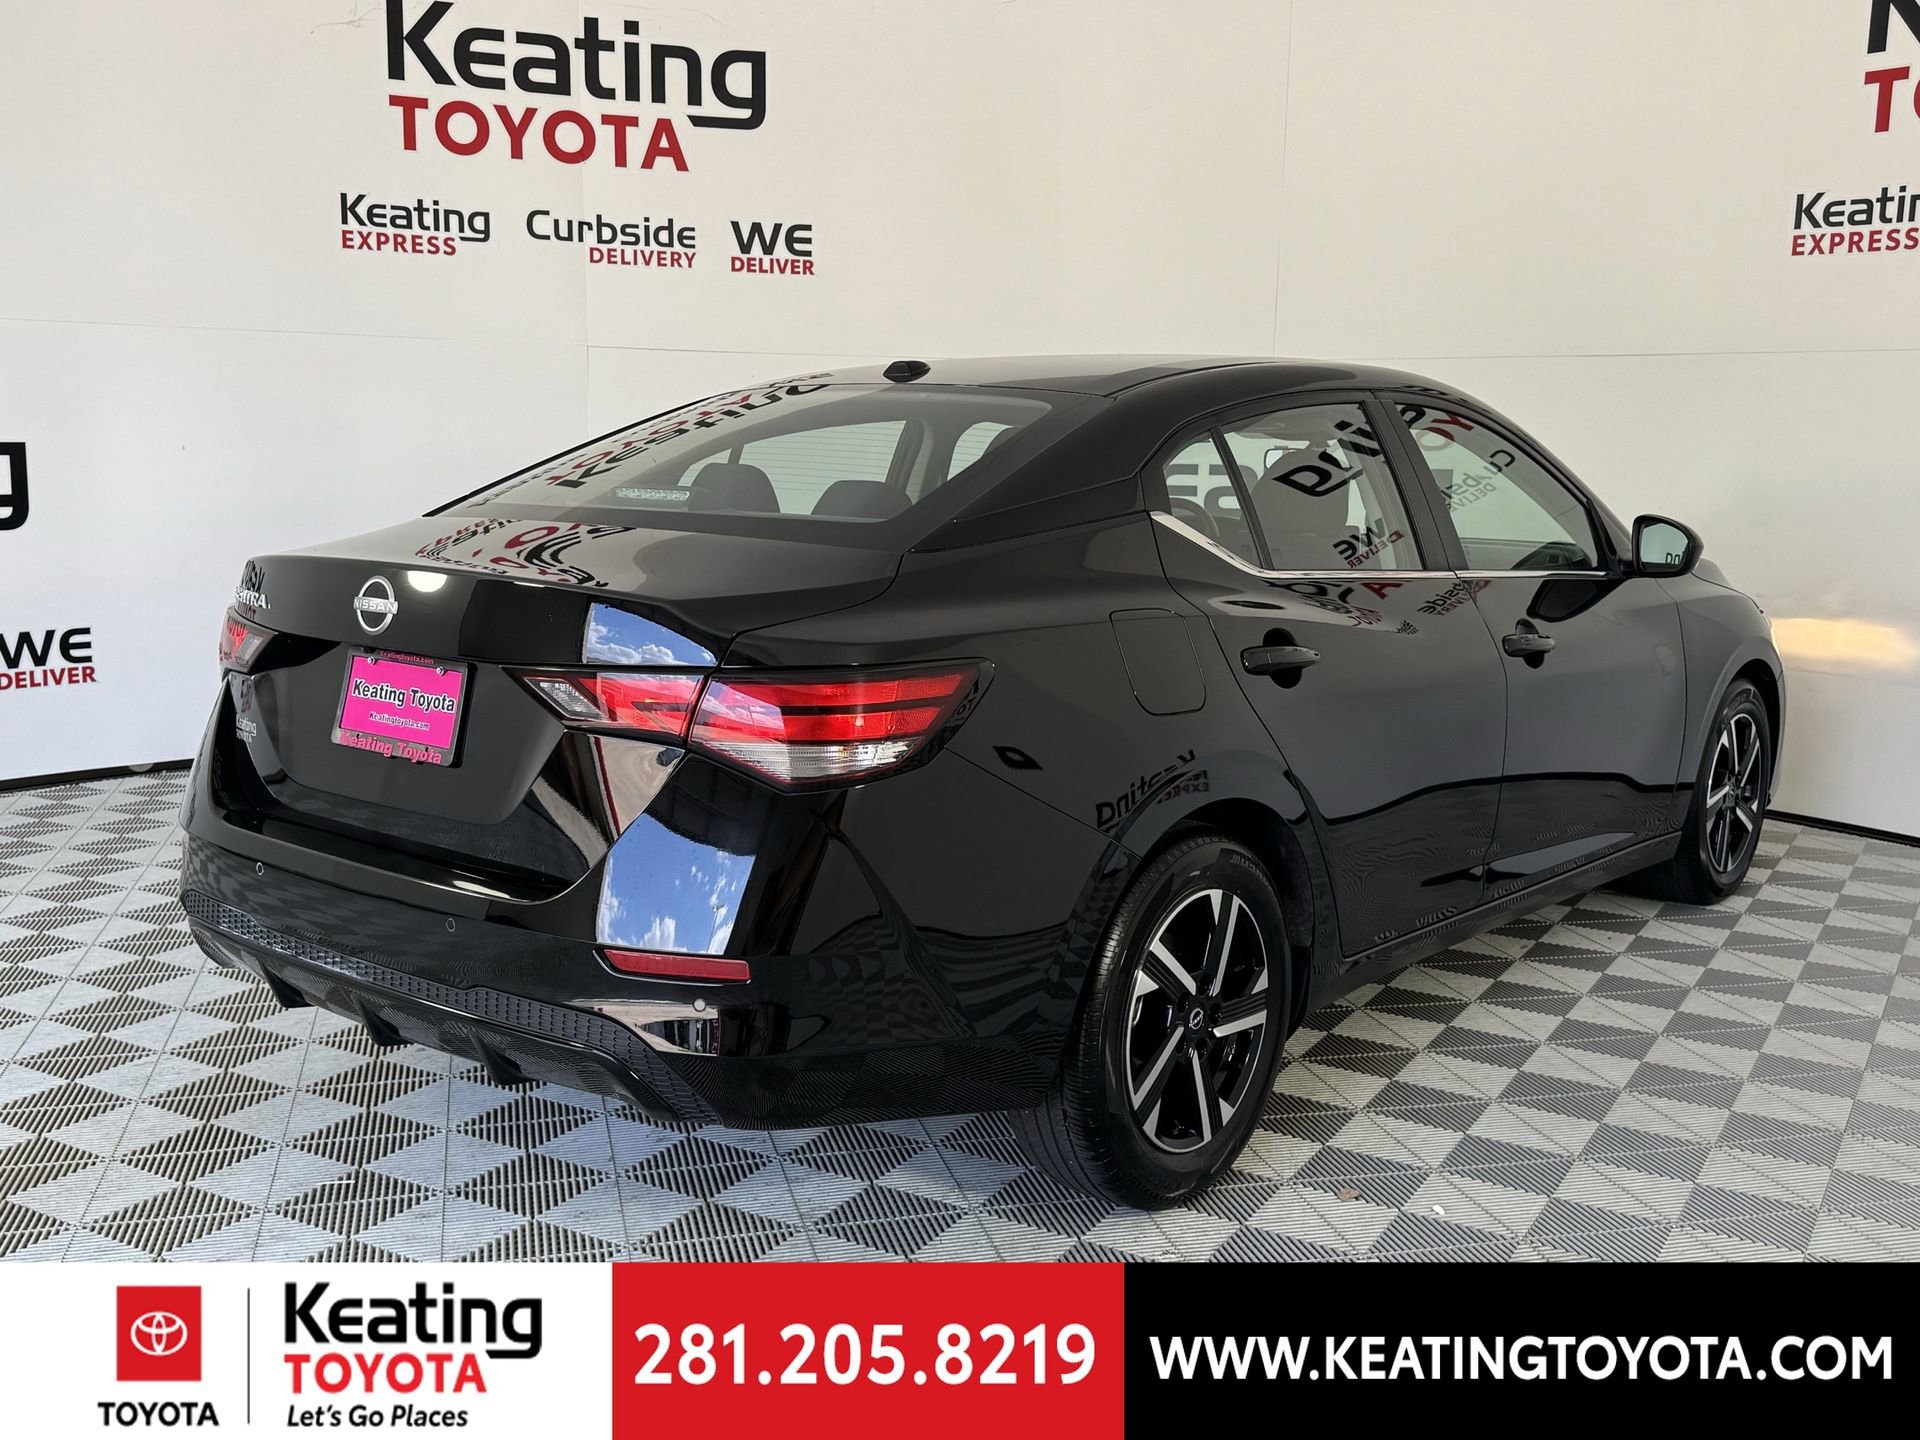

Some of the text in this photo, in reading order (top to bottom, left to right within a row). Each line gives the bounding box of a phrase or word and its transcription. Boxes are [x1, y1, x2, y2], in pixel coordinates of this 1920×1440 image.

[386, 0, 766, 130] Keating
[389, 95, 689, 172] TOYOTA
[341, 193, 490, 243] Keating
[526, 210, 696, 249] Curbside
[342, 230, 456, 256] EXPRESS
[731, 221, 812, 257] WE
[1791, 228, 1920, 256] EXPRESS
[589, 247, 696, 269] DELIVERY
[731, 256, 815, 276] DELIVER
[354, 597, 397, 615] NISSAN
[0, 627, 94, 669] WE
[0, 666, 96, 690] DELIVER
[352, 679, 455, 713] Keating Toyota
[341, 731, 442, 765] Keating Toyota
